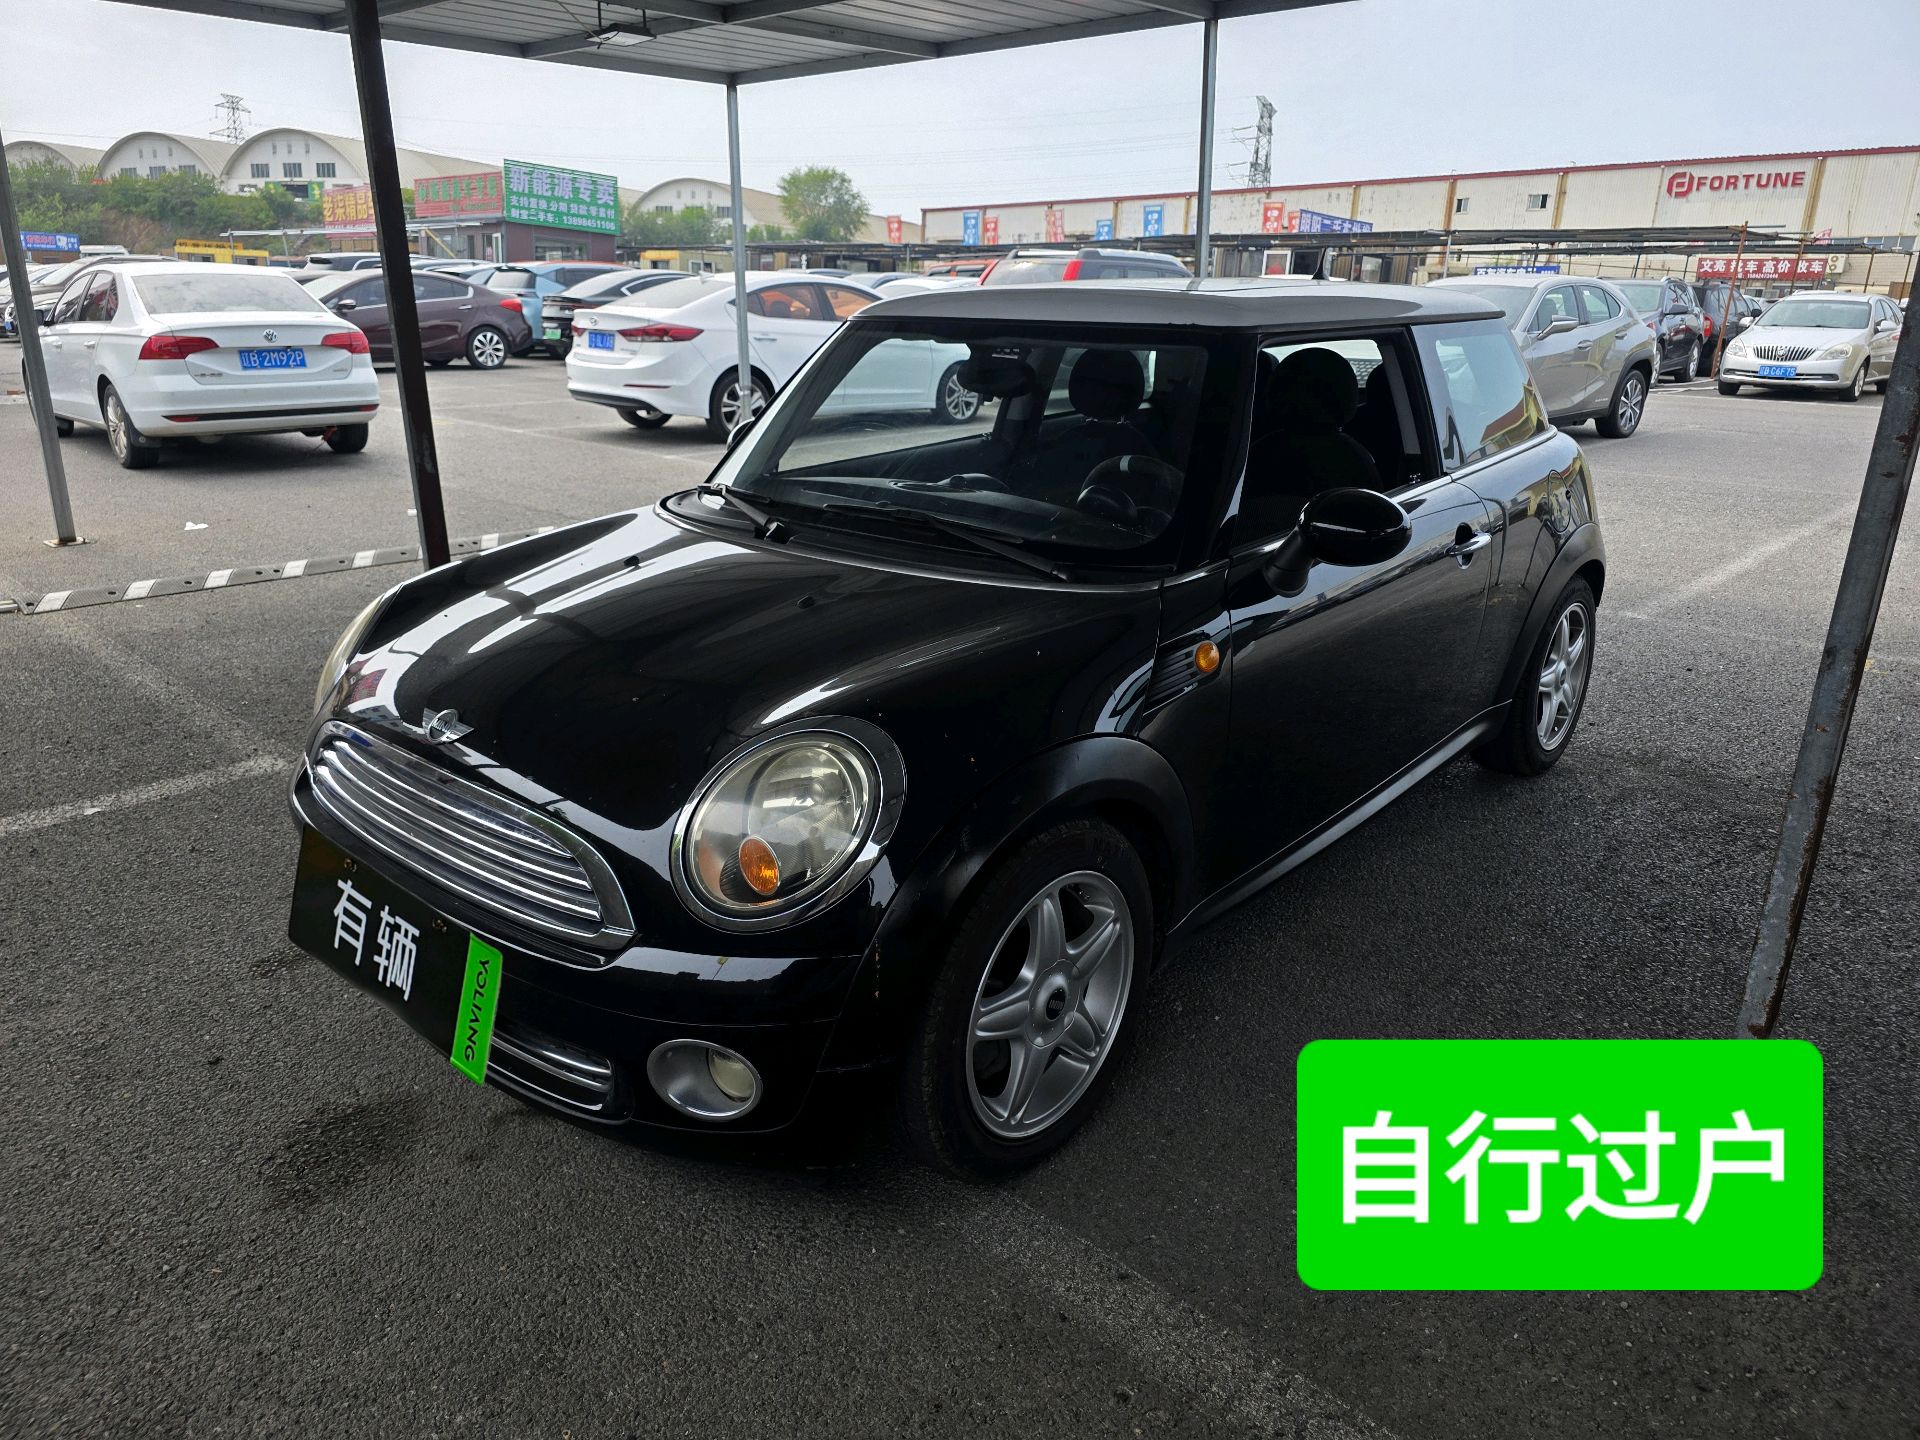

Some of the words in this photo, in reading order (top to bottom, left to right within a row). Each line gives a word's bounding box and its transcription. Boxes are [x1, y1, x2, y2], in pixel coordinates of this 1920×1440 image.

[510, 166, 614, 205] 新能源专卖
[1696, 171, 1806, 191] FORTUNE
[1762, 260, 1791, 273] 高价
[333, 879, 420, 1001] 有辆
[464, 959, 490, 1062] YOLIANG
